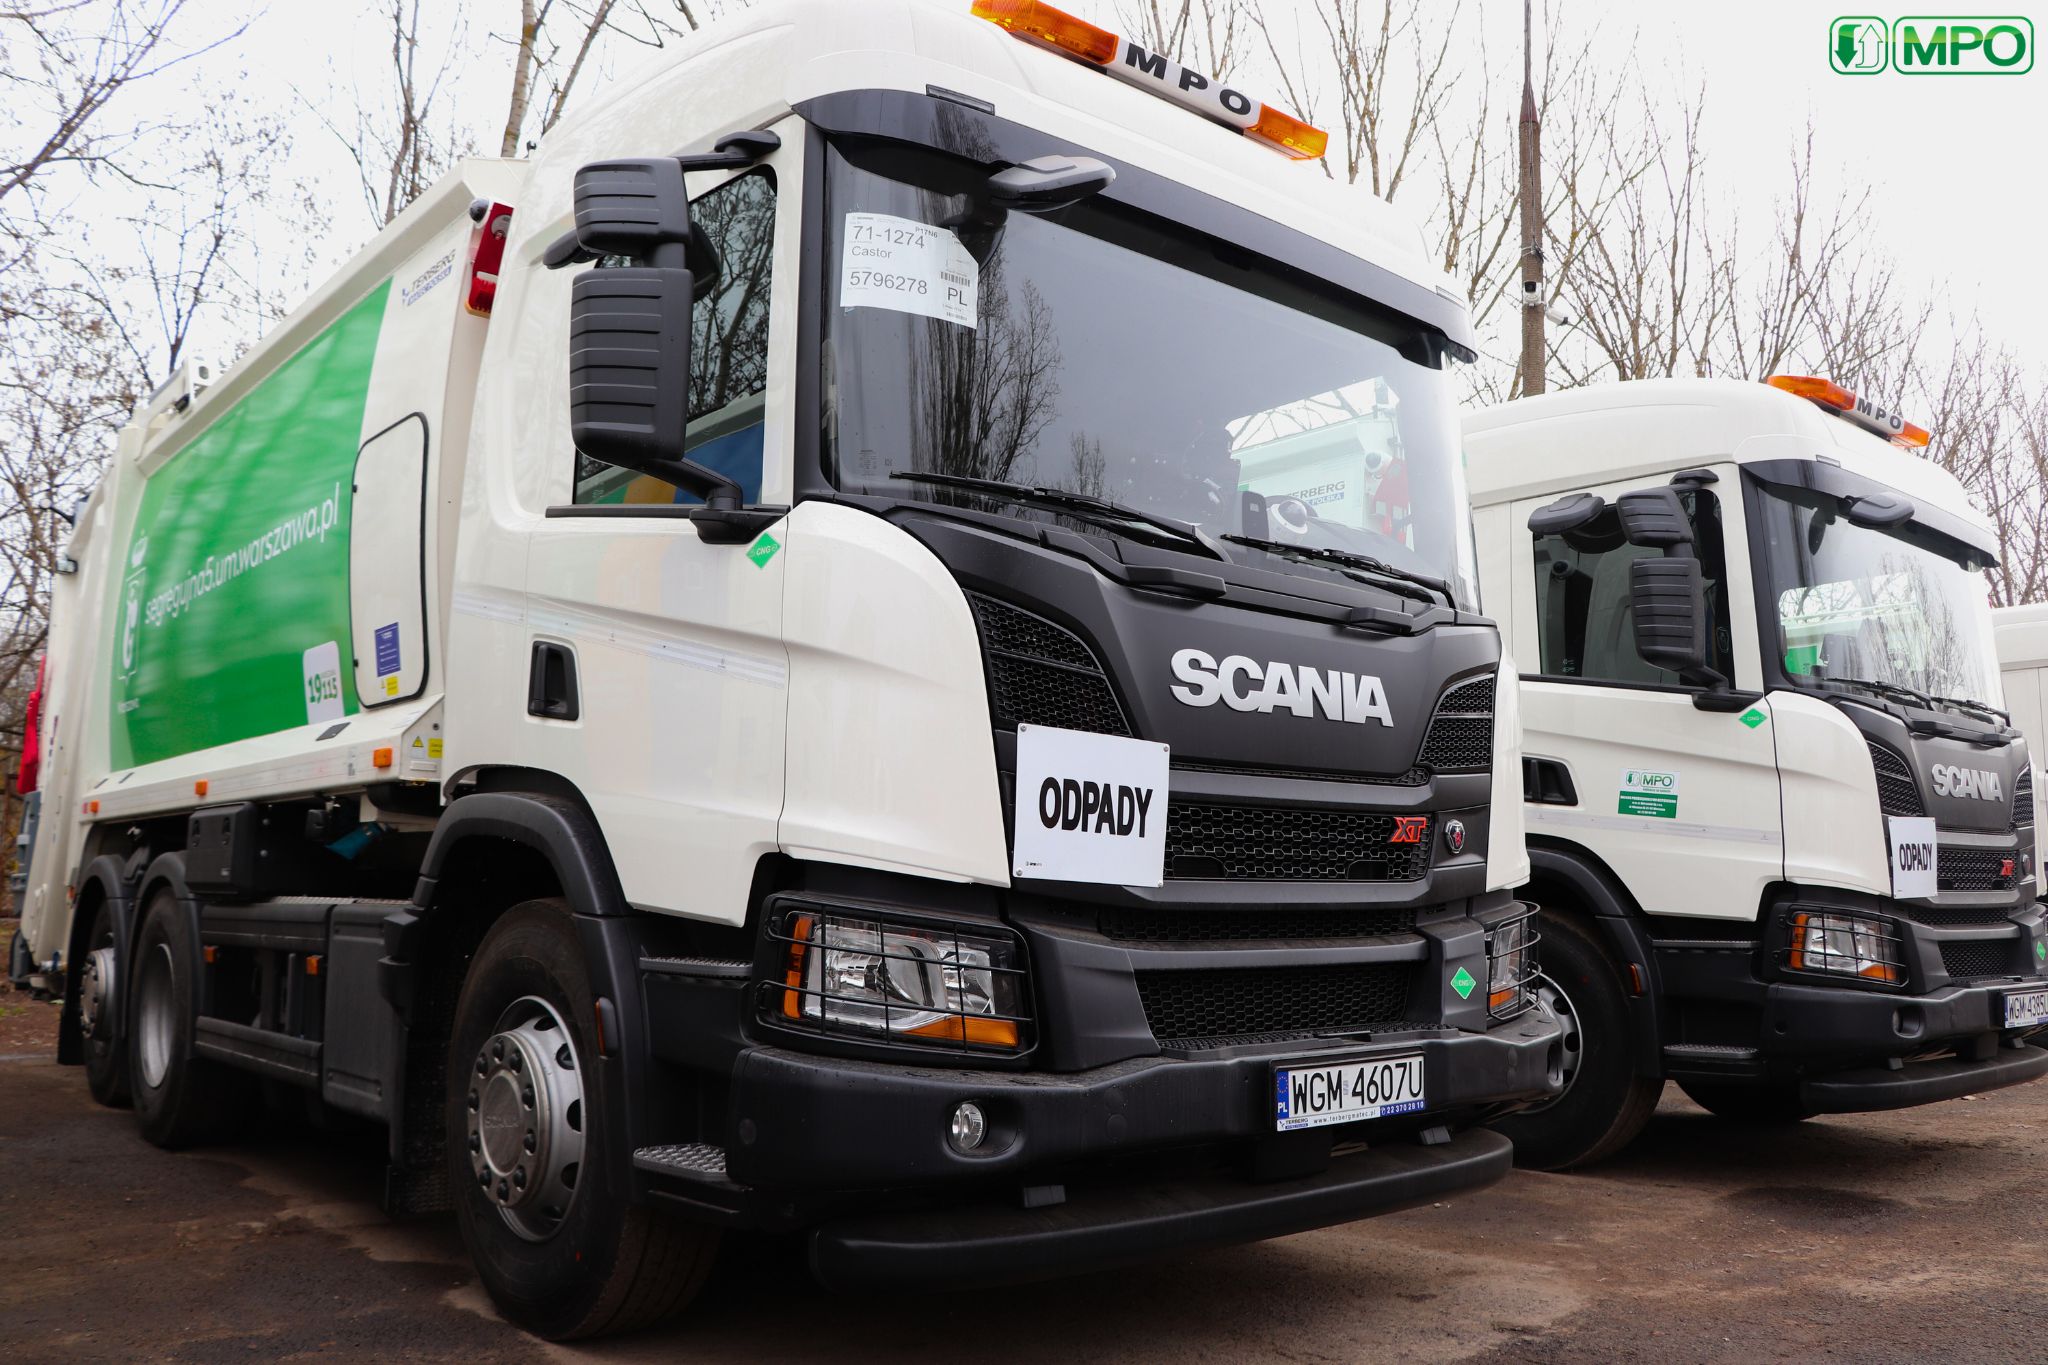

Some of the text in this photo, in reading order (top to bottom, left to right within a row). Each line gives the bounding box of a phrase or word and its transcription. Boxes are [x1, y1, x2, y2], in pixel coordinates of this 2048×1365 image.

[1125, 42, 1252, 116] MPO
[853, 225, 925, 249] 71-1274
[851, 245, 892, 259] Castor
[849, 271, 928, 295] 5796278
[947, 286, 968, 307] PL
[1856, 397, 1902, 430] MPO
[1288, 480, 1346, 499] ERBERG
[145, 481, 341, 626] segregujna5.um.warszawa.pl
[1168, 647, 1395, 728] SCANIA
[1643, 774, 1673, 787] MPO
[1931, 763, 2004, 803] SCANIA
[1038, 776, 1154, 839] ODPADY
[1391, 816, 1427, 844] XT
[1898, 842, 1933, 872] ODPADY
[2009, 996, 2026, 1020] WGM
[1292, 1060, 1423, 1115] WGM 4607U
[1277, 1101, 1288, 1113] PL
[1313, 1110, 1377, 1124] www.terbergmatec.pl
[1386, 1106, 1395, 1115] 22
